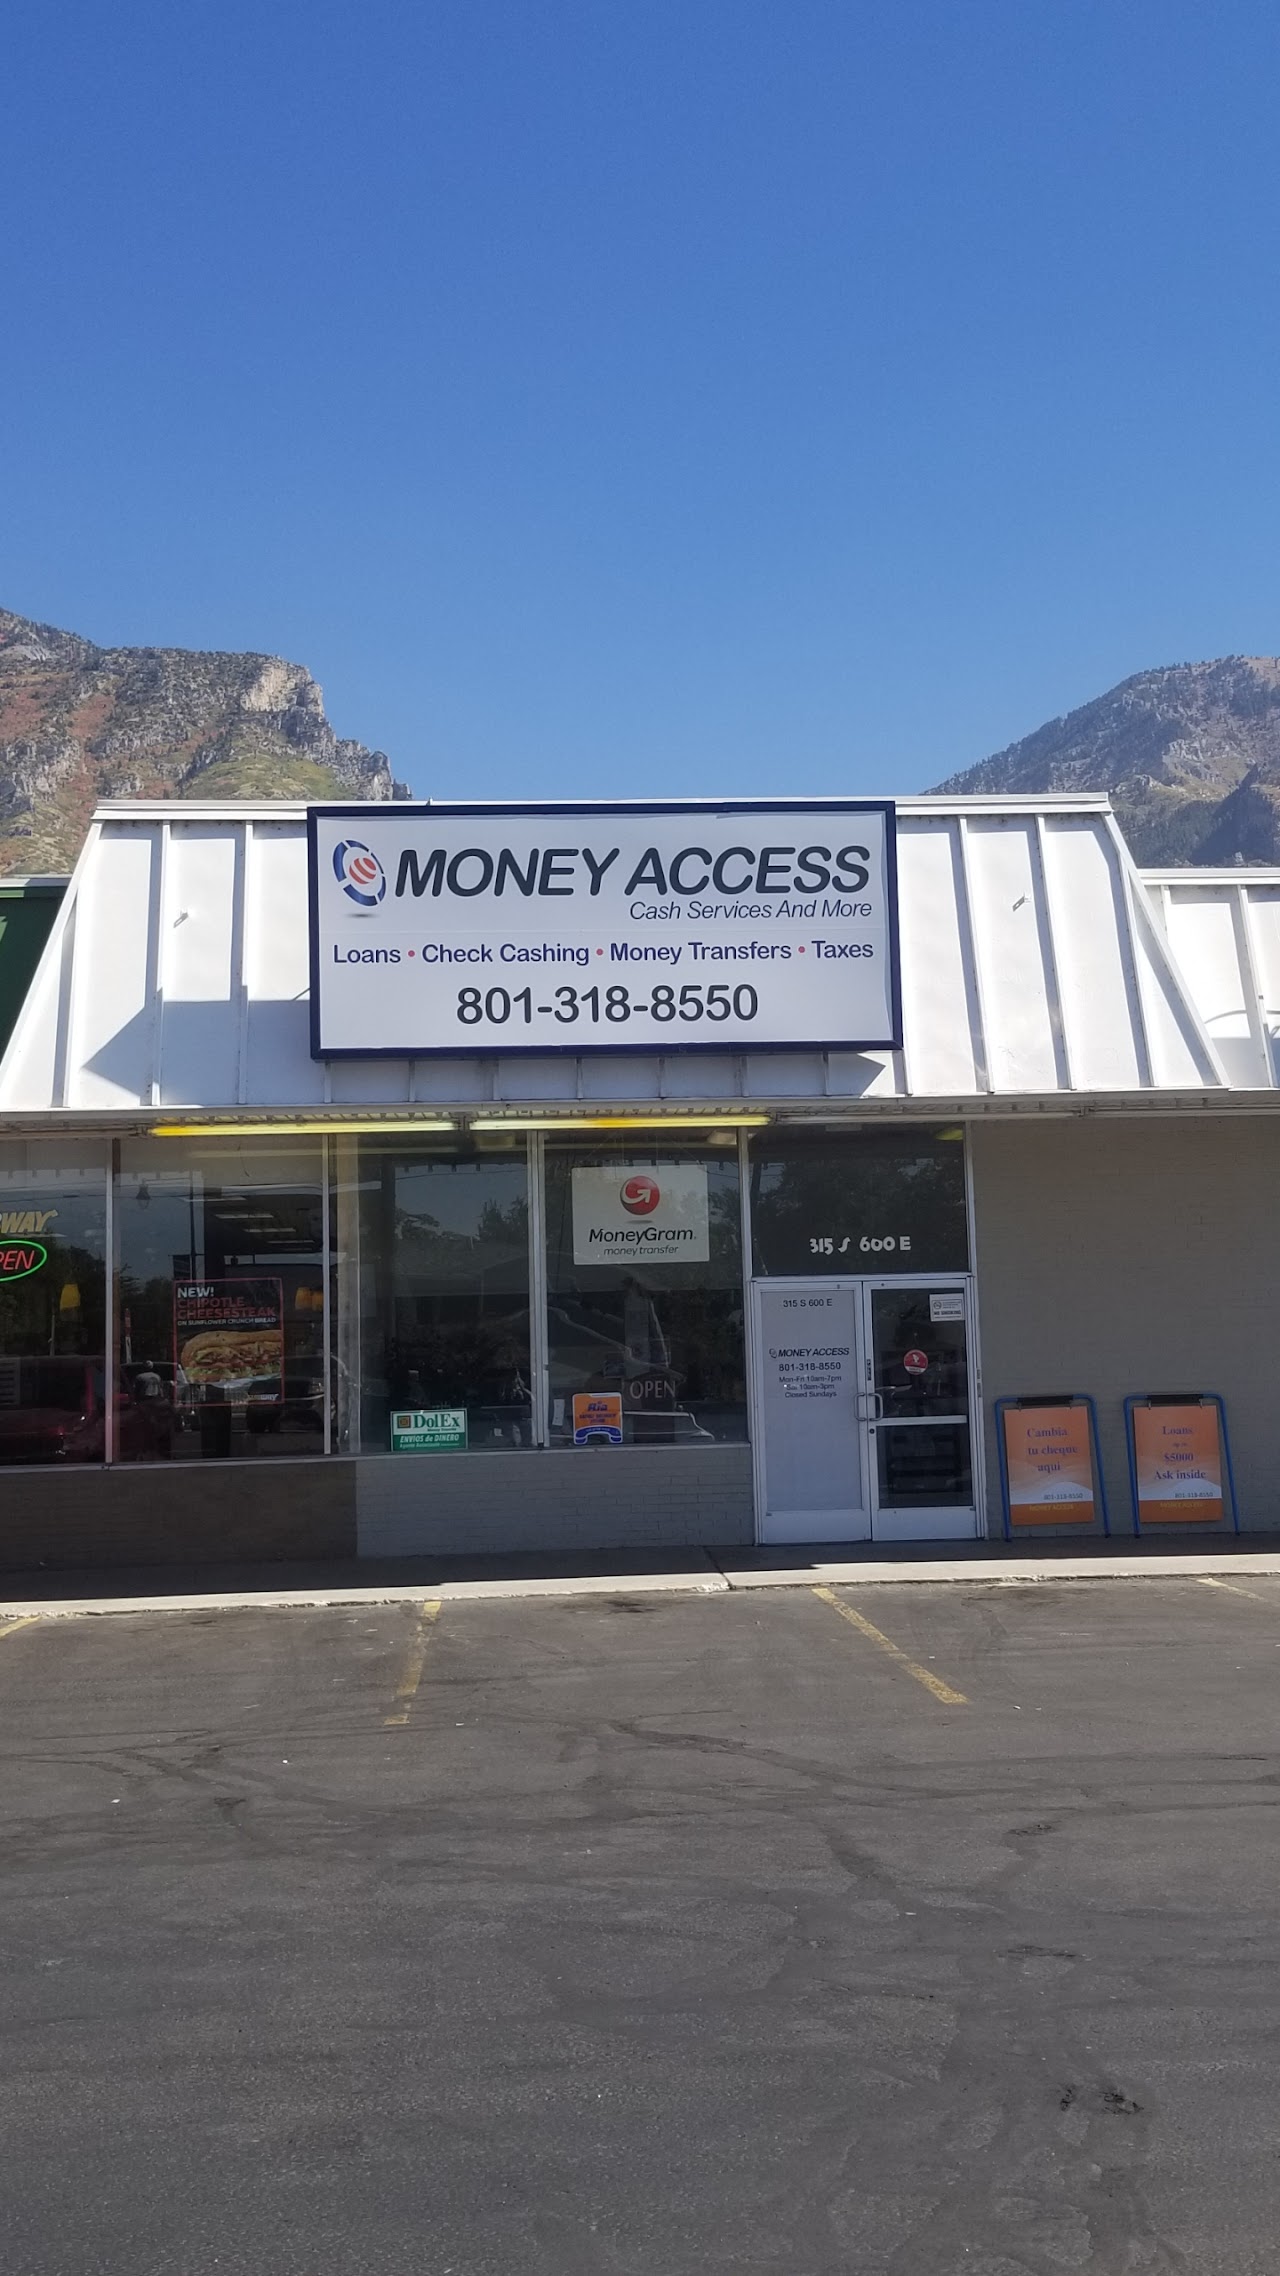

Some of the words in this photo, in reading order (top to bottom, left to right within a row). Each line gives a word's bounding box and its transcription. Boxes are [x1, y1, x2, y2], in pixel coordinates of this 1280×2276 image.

[395, 847, 620, 898] MONEY
[624, 845, 871, 896] ACCESS
[629, 900, 682, 920] Cash
[687, 900, 772, 920] Services
[776, 900, 816, 919] And
[821, 898, 873, 918] More
[333, 944, 402, 964] Loans
[422, 943, 494, 964] Check
[499, 943, 590, 967] Cashing
[609, 942, 681, 966] Money
[688, 940, 792, 961] Transfers
[811, 939, 874, 959] Taxes
[456, 984, 758, 1026] 801-318-8550
[0, 1209, 59, 1234] WAY
[588, 1227, 694, 1245] MoneyGram
[603, 1247, 638, 1257] money
[639, 1244, 679, 1254] transfer
[809, 1237, 834, 1255] 315
[837, 1237, 851, 1253] S
[859, 1236, 896, 1252] 600
[899, 1236, 912, 1251] E
[177, 1286, 215, 1298] NEW!
[177, 1297, 245, 1308] CHIPOTLE
[783, 1299, 798, 1308] 315
[800, 1299, 807, 1307] S
[808, 1298, 825, 1307] 600
[826, 1298, 833, 1306] E
[177, 1307, 276, 1320] CHEESESTEAK
[777, 1348, 812, 1357] MONEY
[812, 1347, 850, 1356] ACCESS
[778, 1361, 842, 1372] 801-318-8550
[630, 1380, 676, 1399] OPEN
[413, 1413, 460, 1429] DolEx
[1026, 1427, 1068, 1438] Cambia
[1162, 1426, 1193, 1435] Loans
[433, 1433, 460, 1442] DINERO
[1027, 1447, 1039, 1456] tu
[1041, 1445, 1078, 1456] cheque
[1154, 1470, 1174, 1480] Ask
[1176, 1469, 1206, 1480] inside
